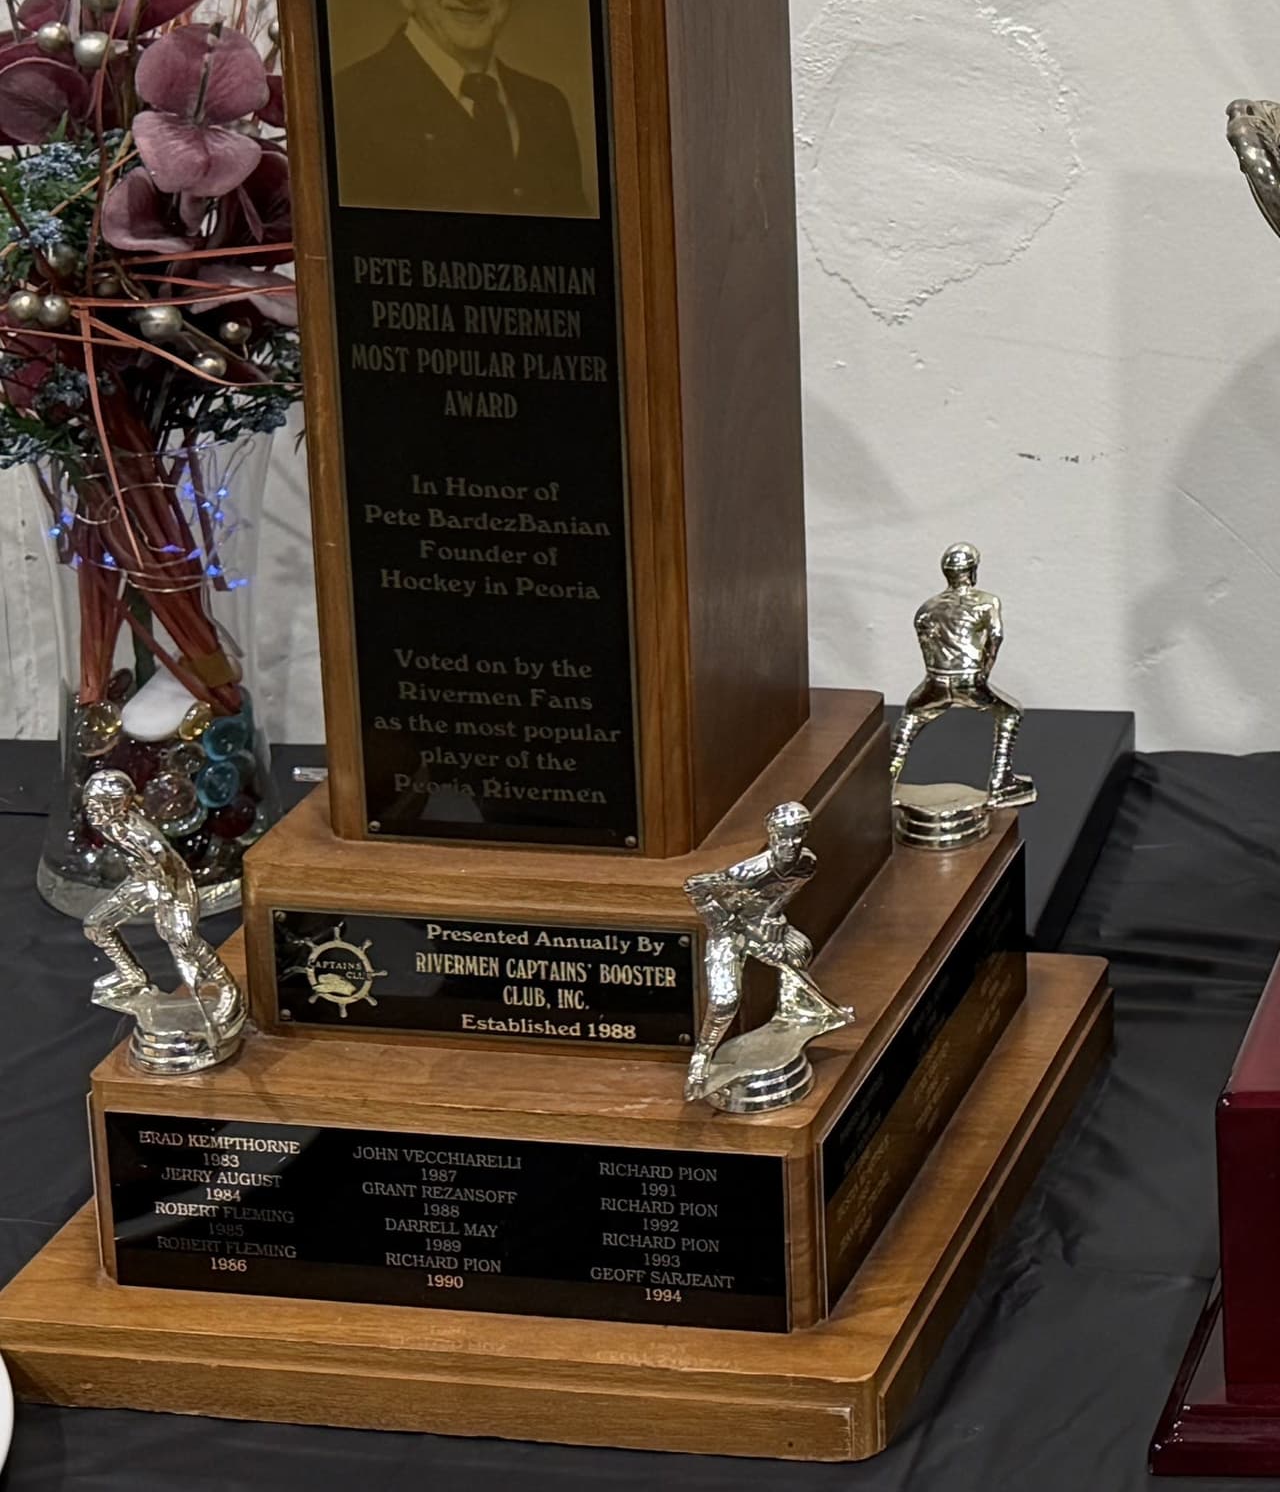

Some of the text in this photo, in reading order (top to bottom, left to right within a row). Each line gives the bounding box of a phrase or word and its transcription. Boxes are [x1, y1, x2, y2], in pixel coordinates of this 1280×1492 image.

[354, 256, 596, 295] PETE BARDEZBANIAN
[372, 301, 581, 339] PEORIA RIVERMEN
[352, 344, 607, 382] MOST POPULAR PLAYER
[444, 390, 518, 419] AWARD
[426, 924, 665, 956] Presented Annually By
[415, 952, 676, 988] RIVERMEN CAPTAINS' BOOSTER
[503, 986, 590, 1011] CLUB, INC.
[462, 1013, 637, 1041] Established 1988
[139, 1130, 300, 1155] BRAD KEMPTHORNE
[203, 1153, 239, 1168] 1983
[352, 1146, 522, 1170] JOHN VECCHIARELLI
[161, 1167, 282, 1188] JERRY AUGUST
[421, 1167, 457, 1183] 1987
[600, 1162, 717, 1182] RICHARD PION
[206, 1187, 241, 1202] 1984
[362, 1182, 518, 1204] GRANT REZANSOFF
[641, 1183, 676, 1197] 1991
[423, 1202, 460, 1218] 1988
[600, 1198, 718, 1217] RICHARD PION
[385, 1217, 498, 1238] DARRELL MAY
[642, 1218, 679, 1232] 1992
[425, 1238, 462, 1253] 1989
[602, 1233, 719, 1252] RICHARD PION
[386, 1252, 502, 1273] RICHARD PION
[644, 1253, 680, 1267] 1993
[427, 1274, 464, 1289] 1990
[590, 1267, 734, 1289] GEOFF SARJEANT
[645, 1288, 682, 1303] 1994
